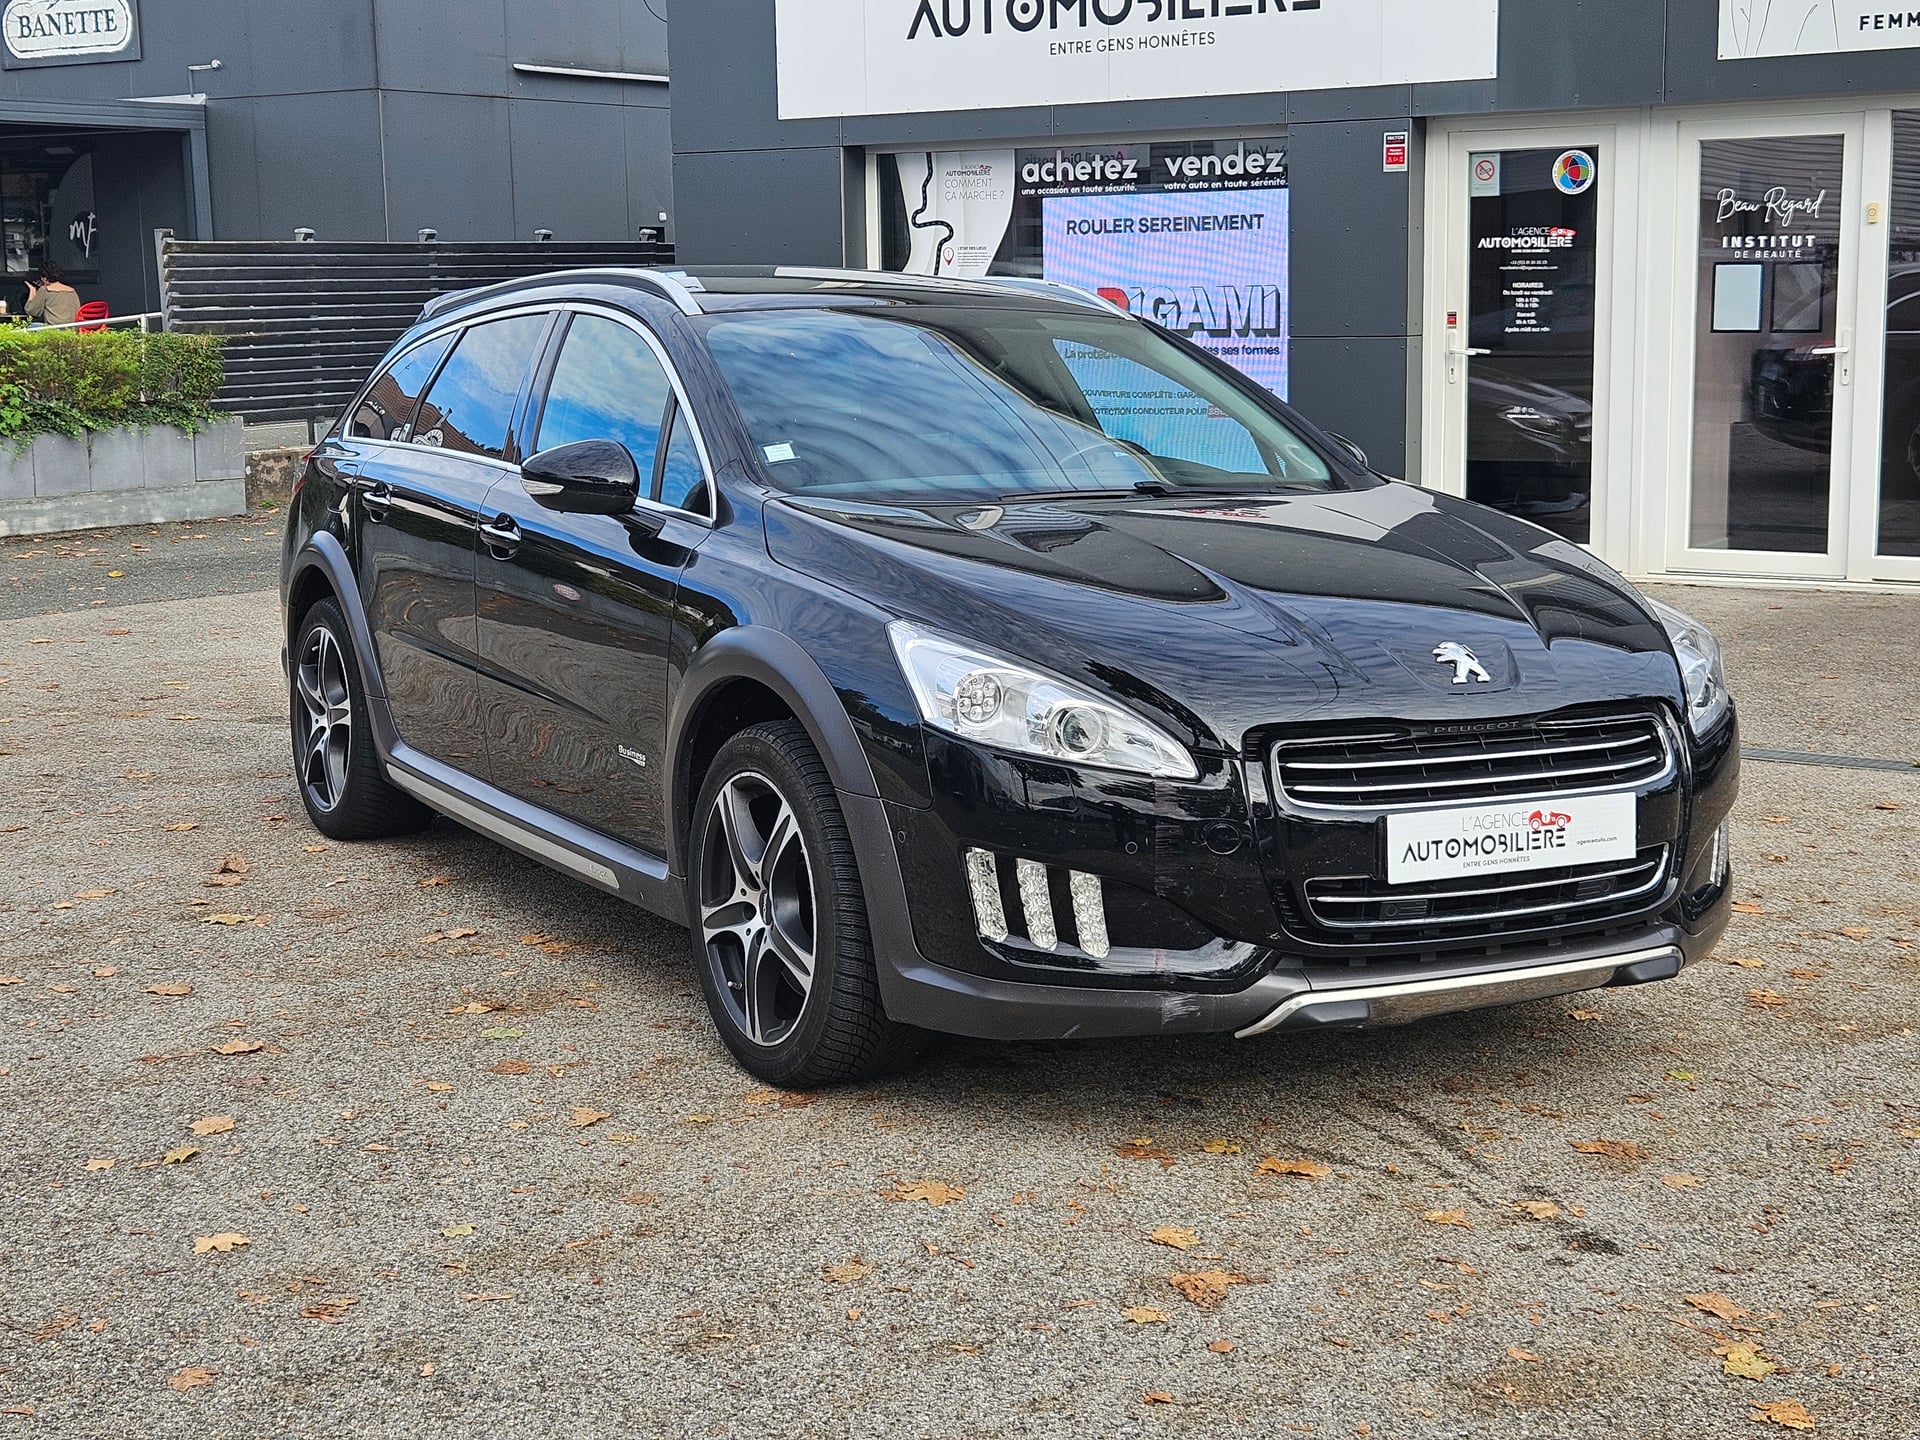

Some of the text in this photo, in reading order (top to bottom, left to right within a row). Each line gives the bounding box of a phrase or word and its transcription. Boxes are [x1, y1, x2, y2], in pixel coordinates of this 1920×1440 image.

[18, 9, 118, 39] BANETTE
[1049, 30, 1217, 56] ENTRE GENS HONNÊTES
[1164, 141, 1285, 177] vendez
[1021, 149, 1138, 183] achetez
[944, 178, 993, 189] COMMENT
[1163, 181, 1187, 190] votre
[1188, 180, 1209, 189] auto
[1224, 179, 1248, 188] toute
[944, 191, 957, 202] ÇA
[958, 190, 998, 201] MARCHE
[1037, 186, 1069, 195] occasion
[1082, 185, 1103, 193] toute
[1716, 186, 1827, 227] Beau Regard
[1066, 213, 1265, 235] ROULER SEREINEMENT
[1511, 226, 1550, 236] L'AGENCE
[1722, 235, 1816, 248] INSTITUT
[1734, 248, 1802, 258] DE BEAUTÉ
[1064, 347, 1076, 358] La
[1221, 346, 1240, 355] ses
[1241, 344, 1280, 355] formes
[1133, 406, 1185, 416] CONDUCTEUR
[1186, 407, 1207, 416] POUR
[1434, 721, 1519, 733] PEUGEOT
[618, 744, 647, 761] Business
[1461, 811, 1530, 832] L'AGENCE
[1463, 855, 1530, 868] ENTRE GENS HONNÊTES
